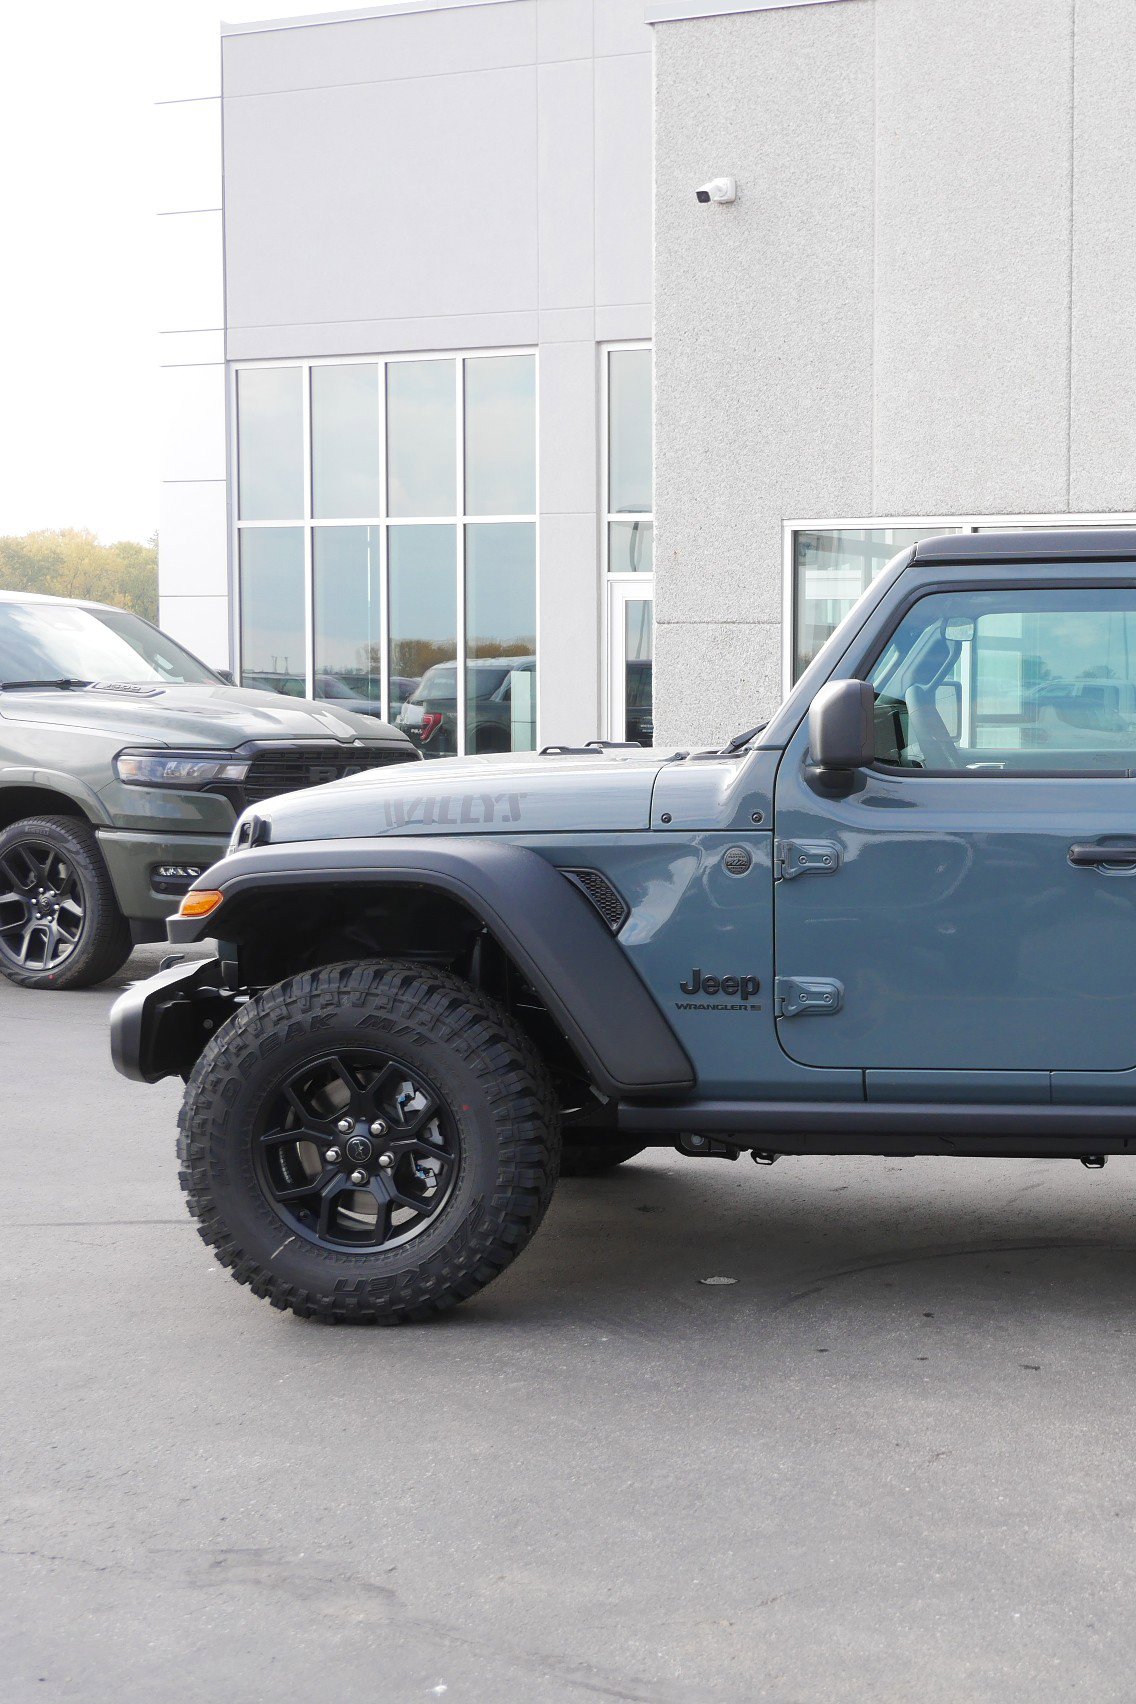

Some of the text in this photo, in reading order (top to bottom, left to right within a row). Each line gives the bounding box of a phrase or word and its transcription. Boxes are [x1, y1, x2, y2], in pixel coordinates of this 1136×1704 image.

[309, 766, 372, 783] RA
[384, 792, 528, 827] WILLYS
[679, 967, 760, 1000] Jeep
[675, 1003, 748, 1011] WRANGLER
